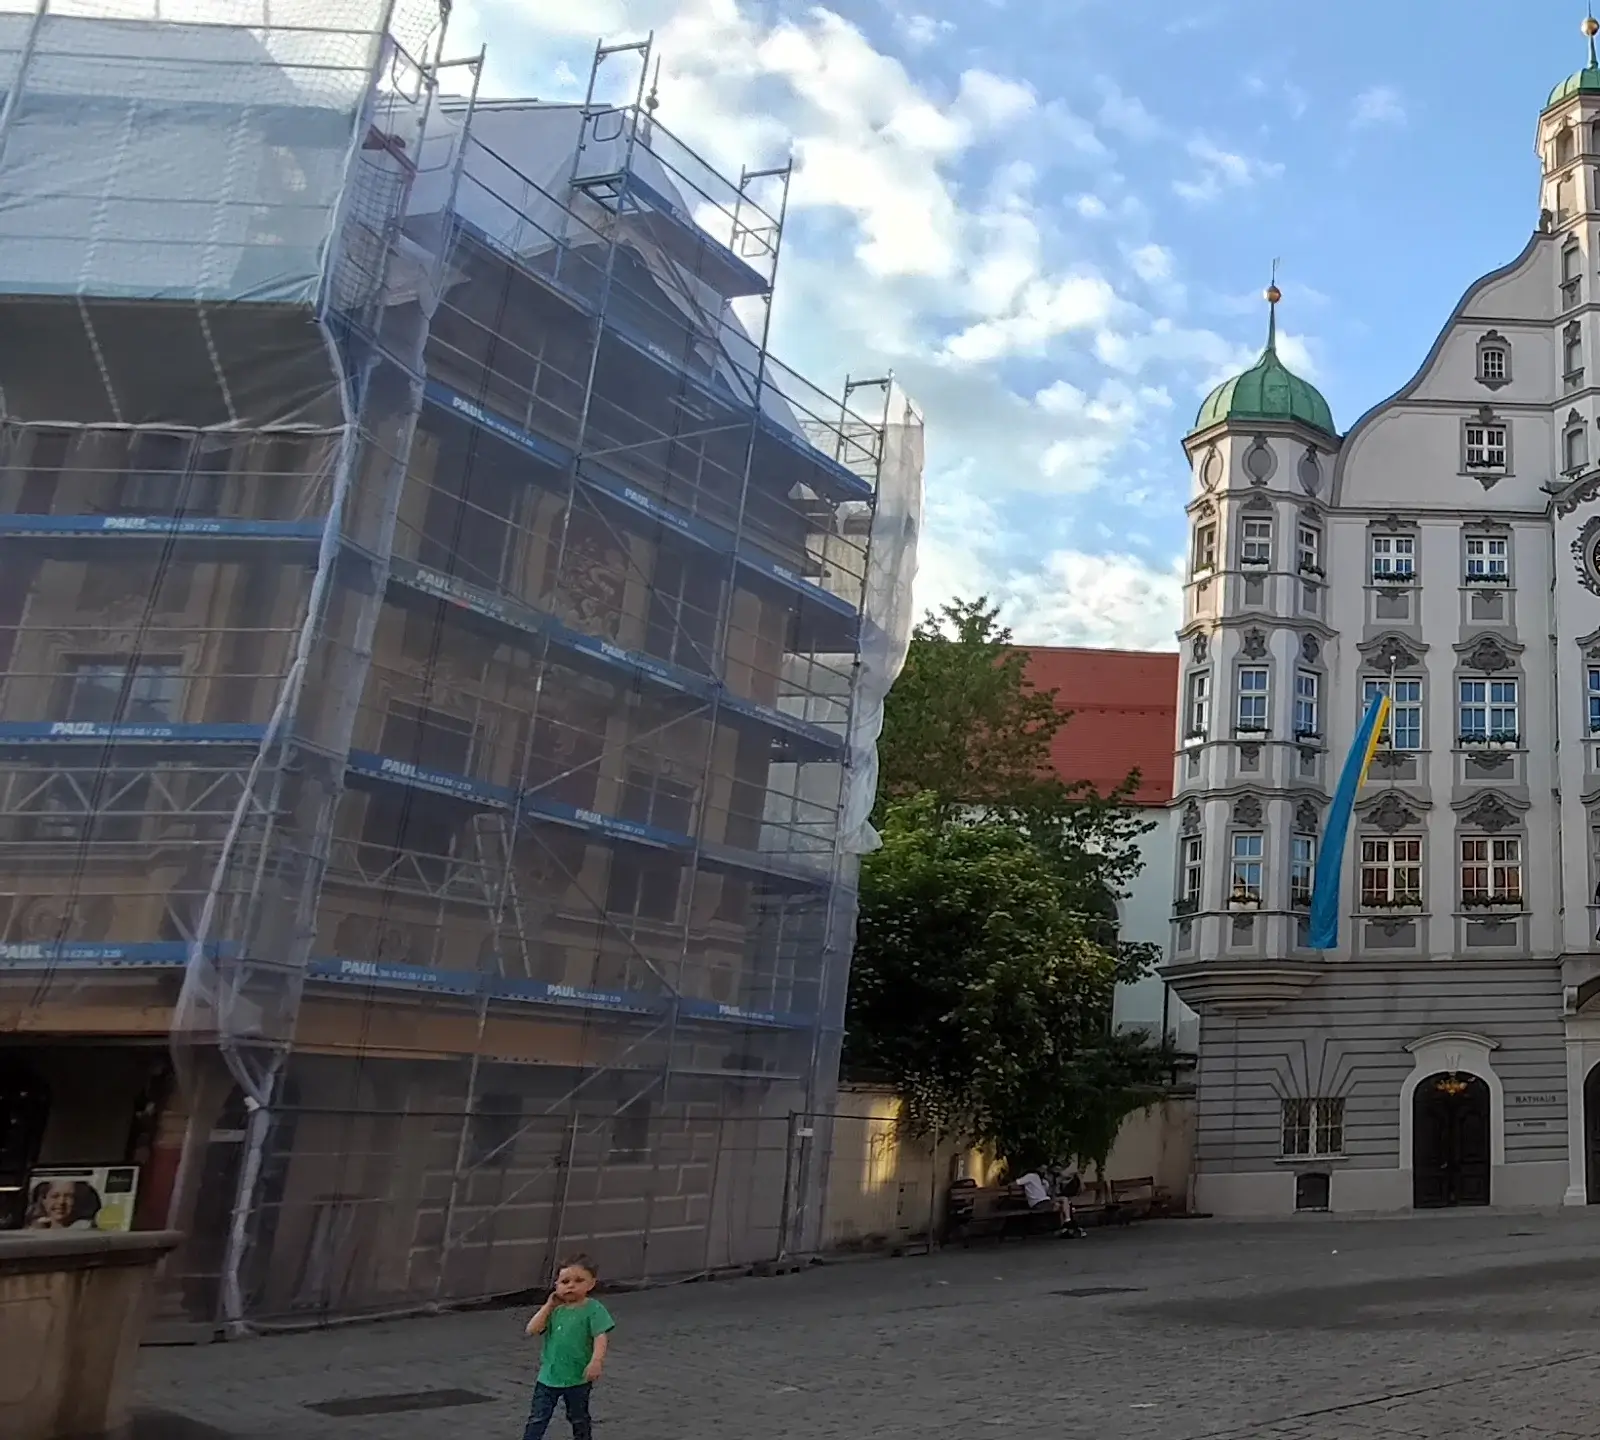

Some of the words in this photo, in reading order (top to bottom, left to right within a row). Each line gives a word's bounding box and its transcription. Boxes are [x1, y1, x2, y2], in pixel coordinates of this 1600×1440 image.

[453, 396, 485, 422] PAUL
[625, 488, 650, 509] PAUL
[103, 517, 147, 530] PAUL
[416, 570, 451, 592] PAUL
[50, 722, 96, 736] PAUL
[381, 758, 417, 778] PAUL
[575, 809, 603, 826] PAUL
[341, 960, 379, 976] PAUL
[546, 984, 577, 998] PAUL
[1515, 1095, 1557, 1104] RATHAUS
